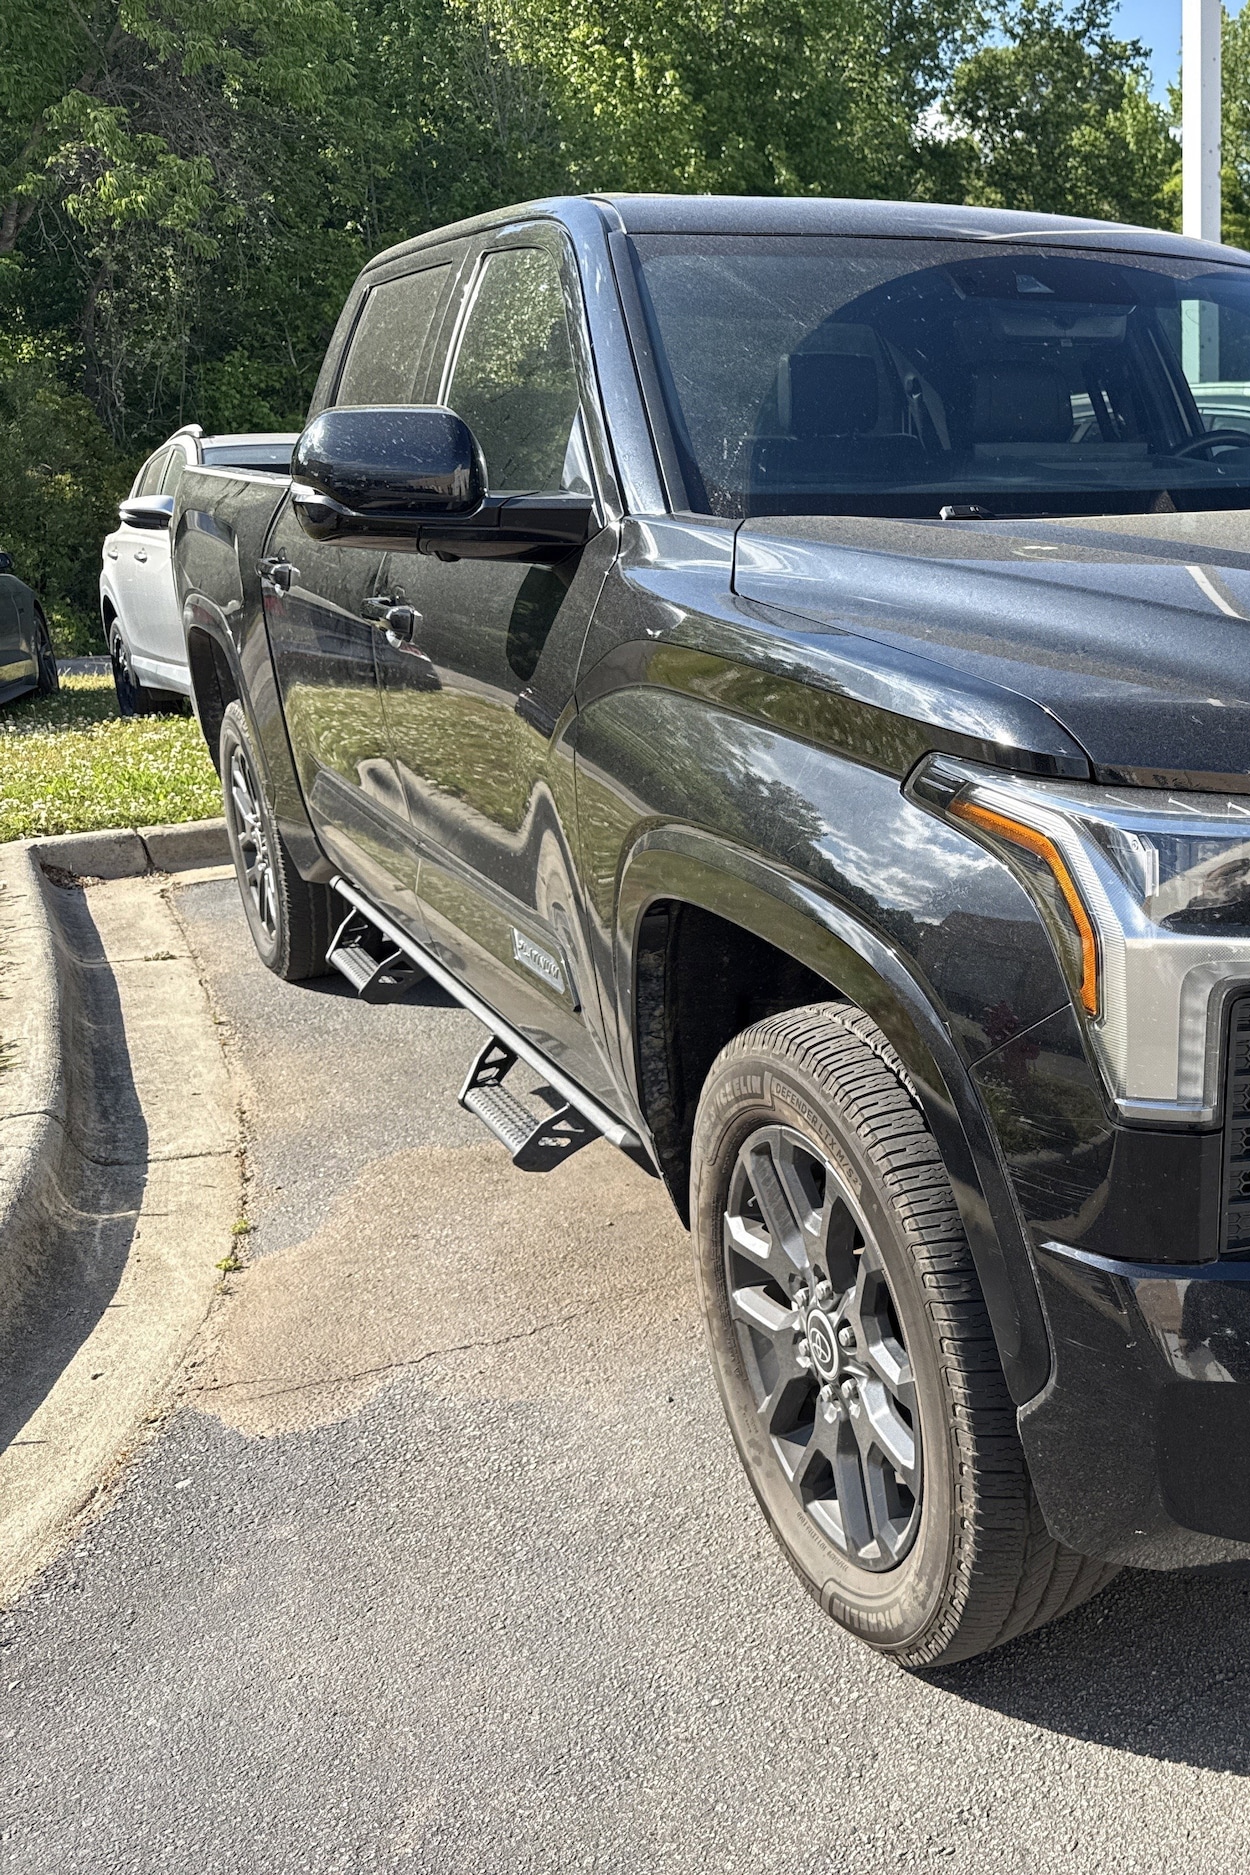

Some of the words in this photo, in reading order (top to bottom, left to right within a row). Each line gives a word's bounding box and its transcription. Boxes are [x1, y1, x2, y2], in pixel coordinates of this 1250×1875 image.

[776, 1082, 818, 1126] DEFENDER
[818, 1123, 837, 1149] LTX
[832, 1598, 903, 1633] MICHELIN
